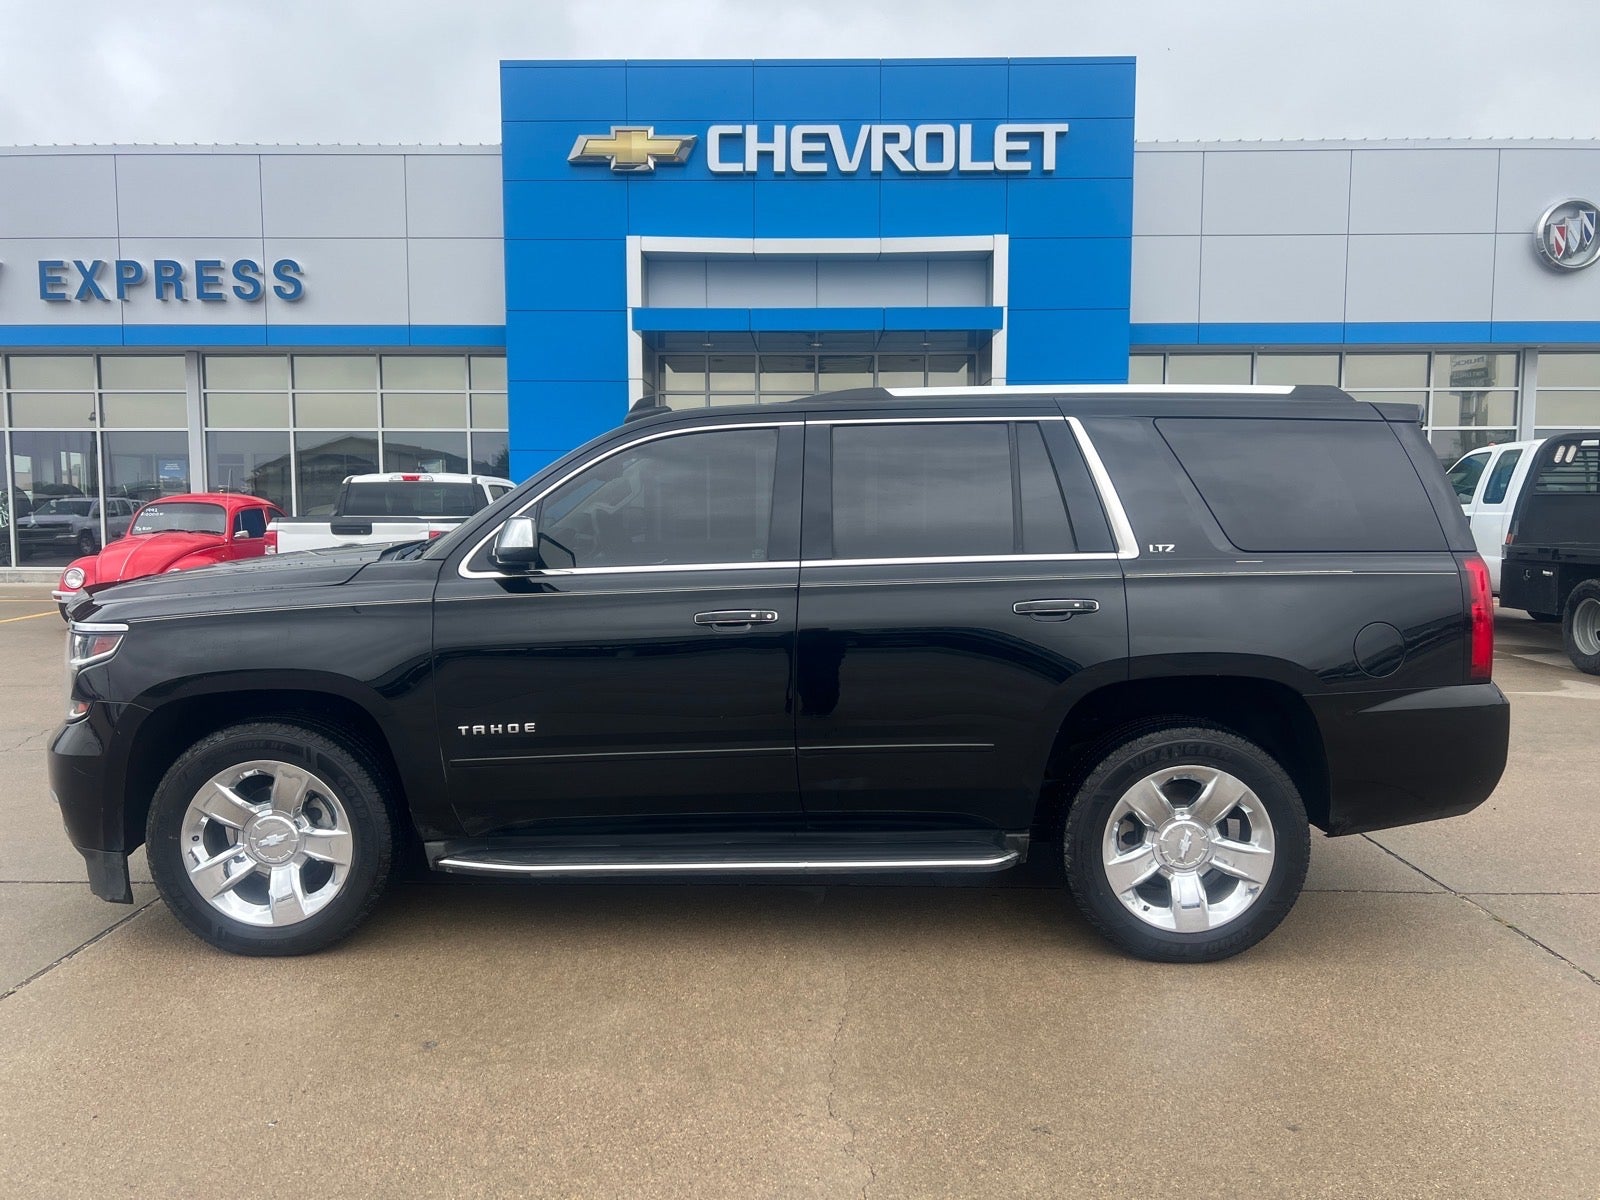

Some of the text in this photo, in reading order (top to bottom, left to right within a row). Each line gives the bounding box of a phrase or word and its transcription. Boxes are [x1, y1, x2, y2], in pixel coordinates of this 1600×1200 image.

[707, 123, 1069, 172] CHEVROLET
[38, 259, 304, 301] EXPRESS
[1149, 544, 1176, 553] LTZ
[457, 722, 536, 736] TAHOE
